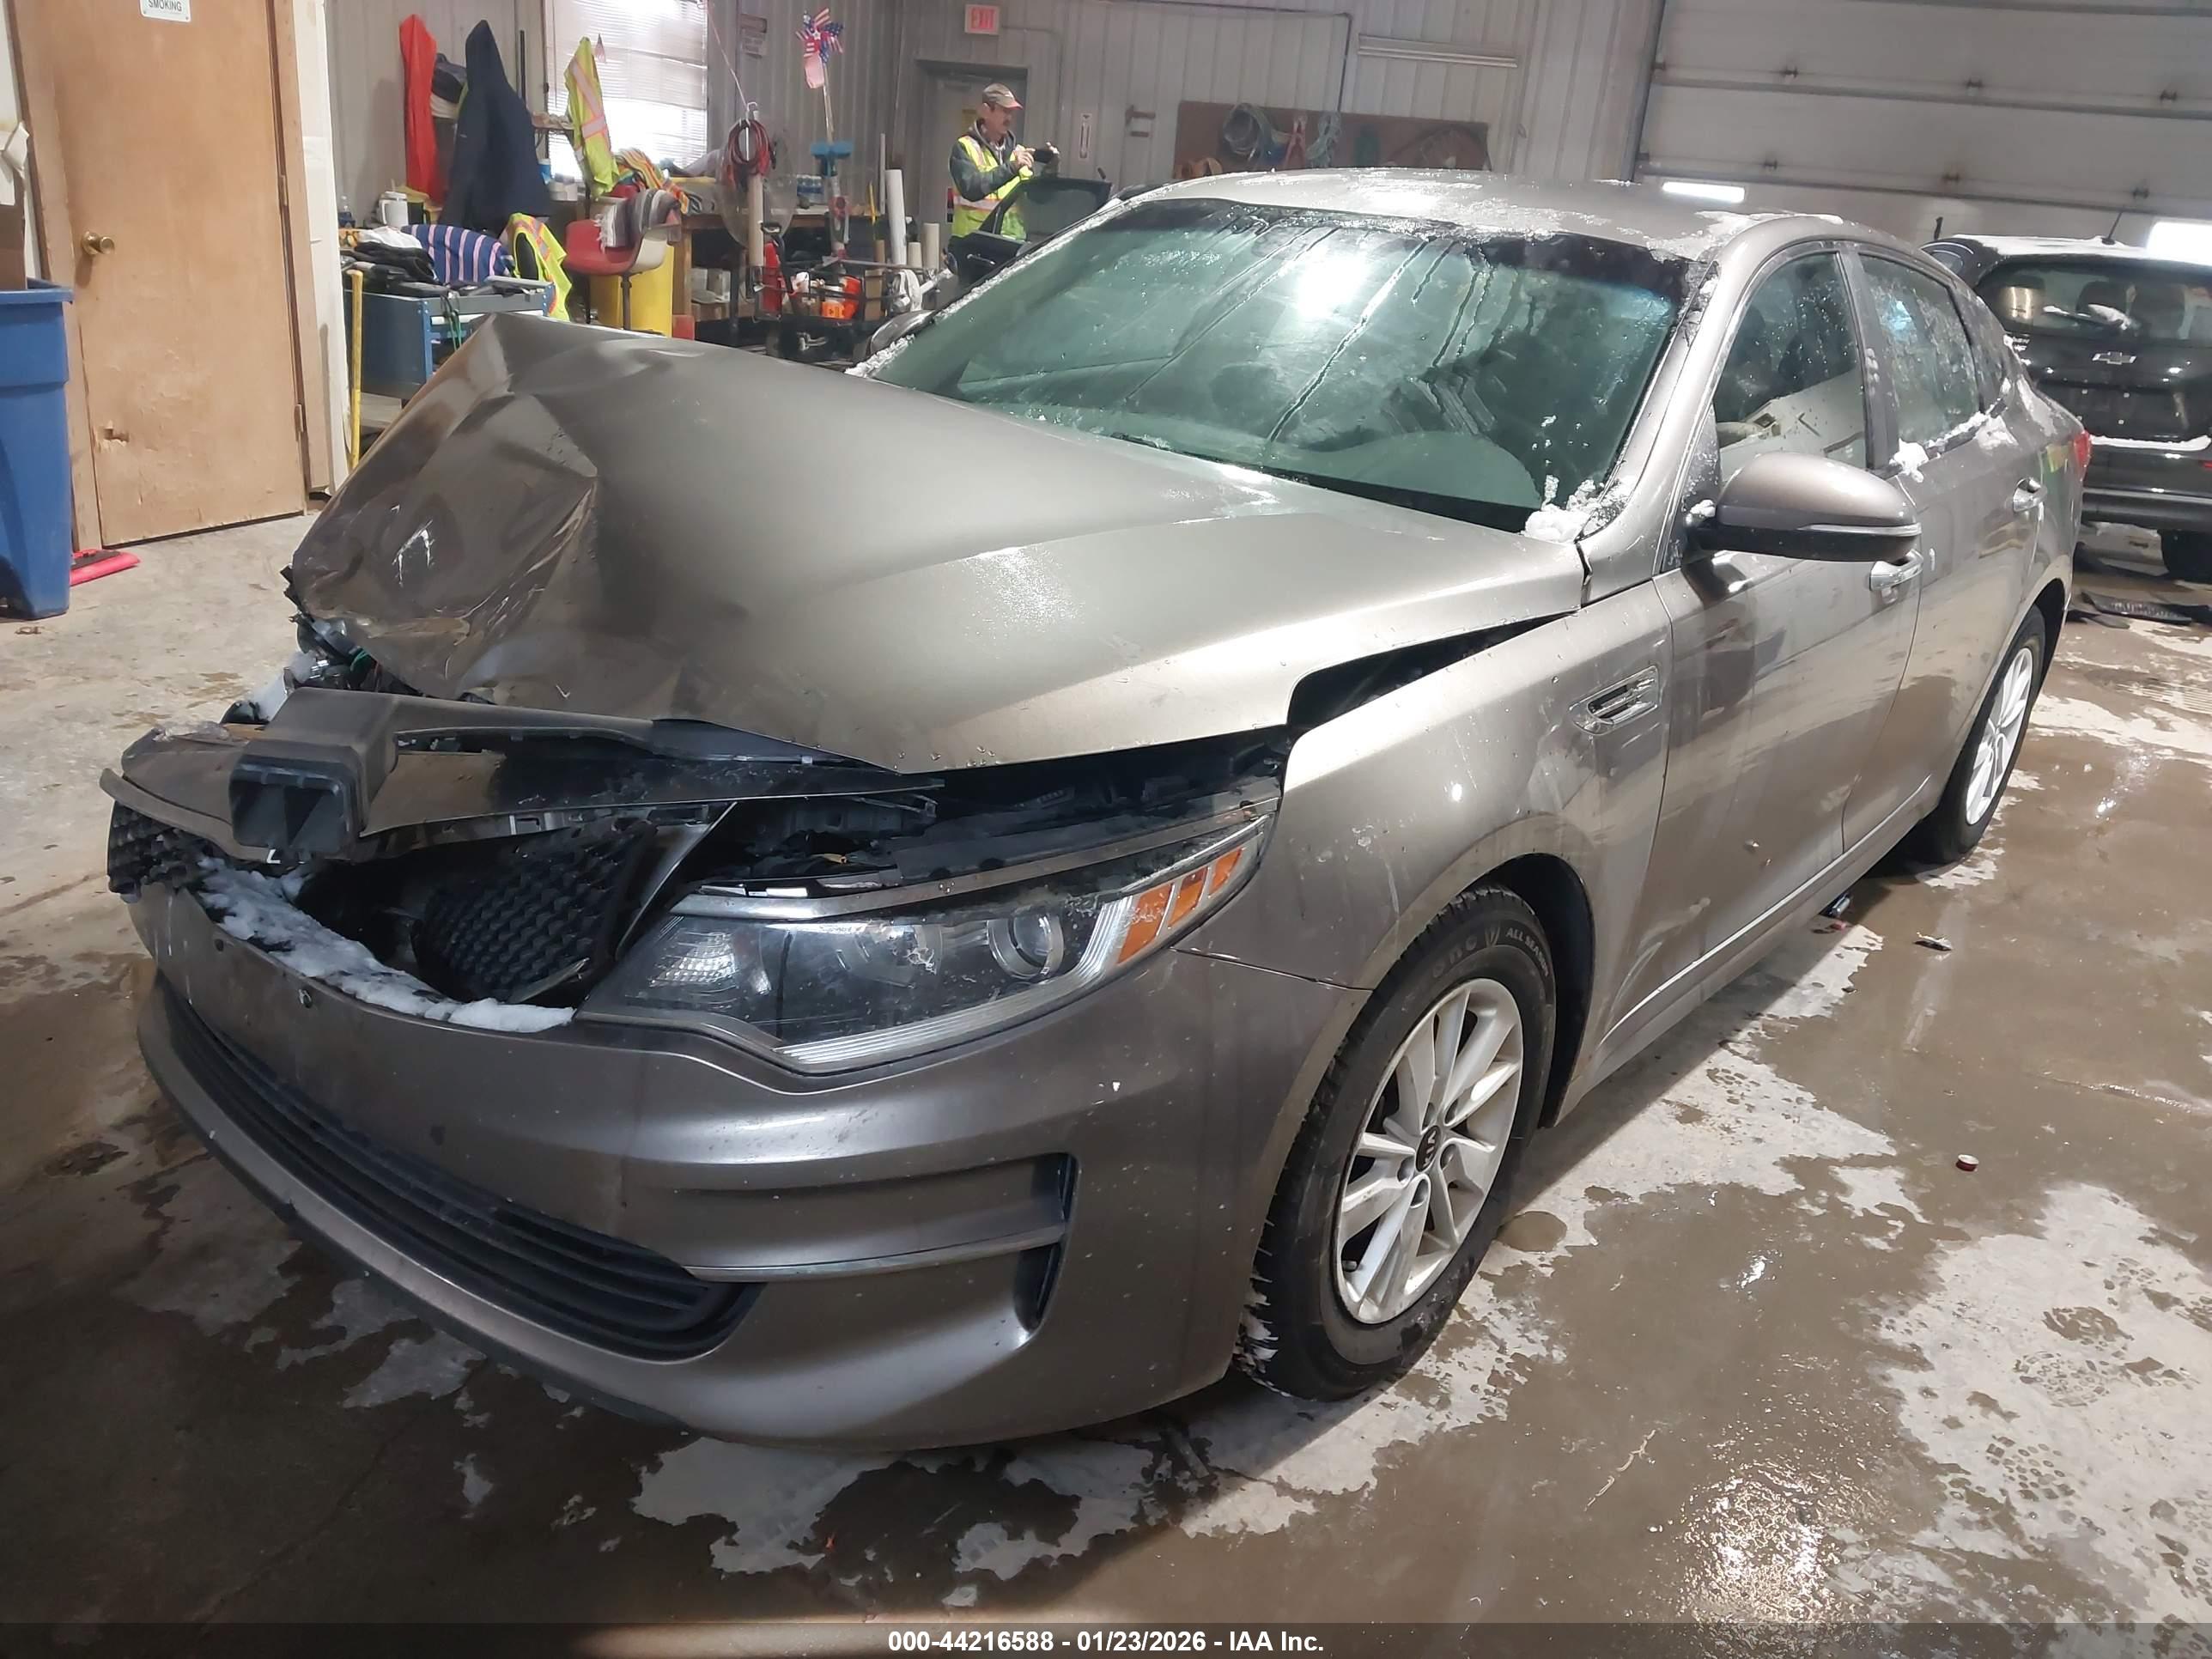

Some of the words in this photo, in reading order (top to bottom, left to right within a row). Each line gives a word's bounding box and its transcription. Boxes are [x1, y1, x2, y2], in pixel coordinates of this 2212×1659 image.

[148, 0, 183, 12] SMOKING
[970, 8, 995, 28] EXIT
[1504, 927, 1524, 942] ALL
